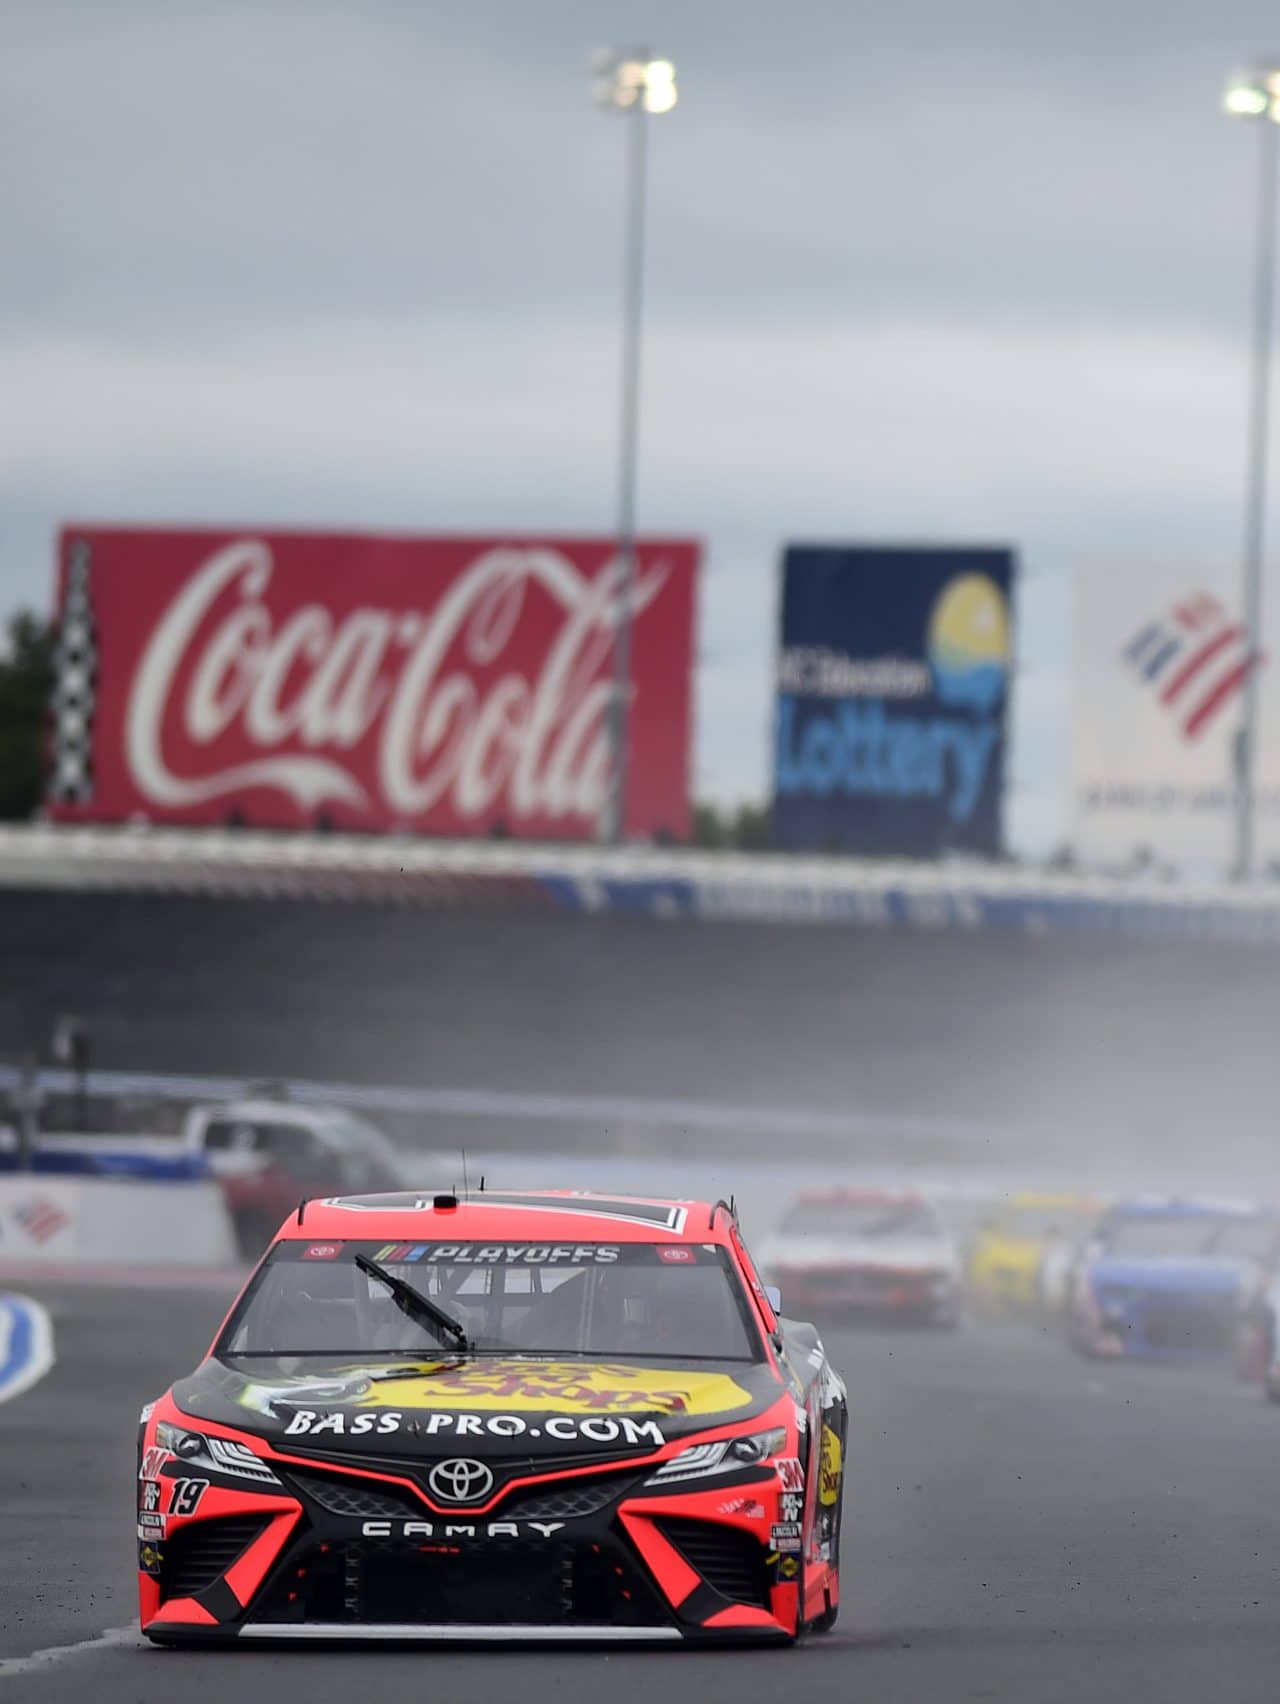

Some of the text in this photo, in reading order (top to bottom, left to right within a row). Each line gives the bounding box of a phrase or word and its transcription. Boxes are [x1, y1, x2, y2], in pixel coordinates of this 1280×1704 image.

[124, 539, 672, 818] Coca-Cola
[777, 696, 999, 824] Lottery
[427, 1245, 620, 1264] PLAYOFFS
[284, 1410, 666, 1446] BASS PRO.COM
[778, 1460, 804, 1489] 3M
[168, 1477, 211, 1517] 19
[362, 1521, 566, 1538] CAMRY
